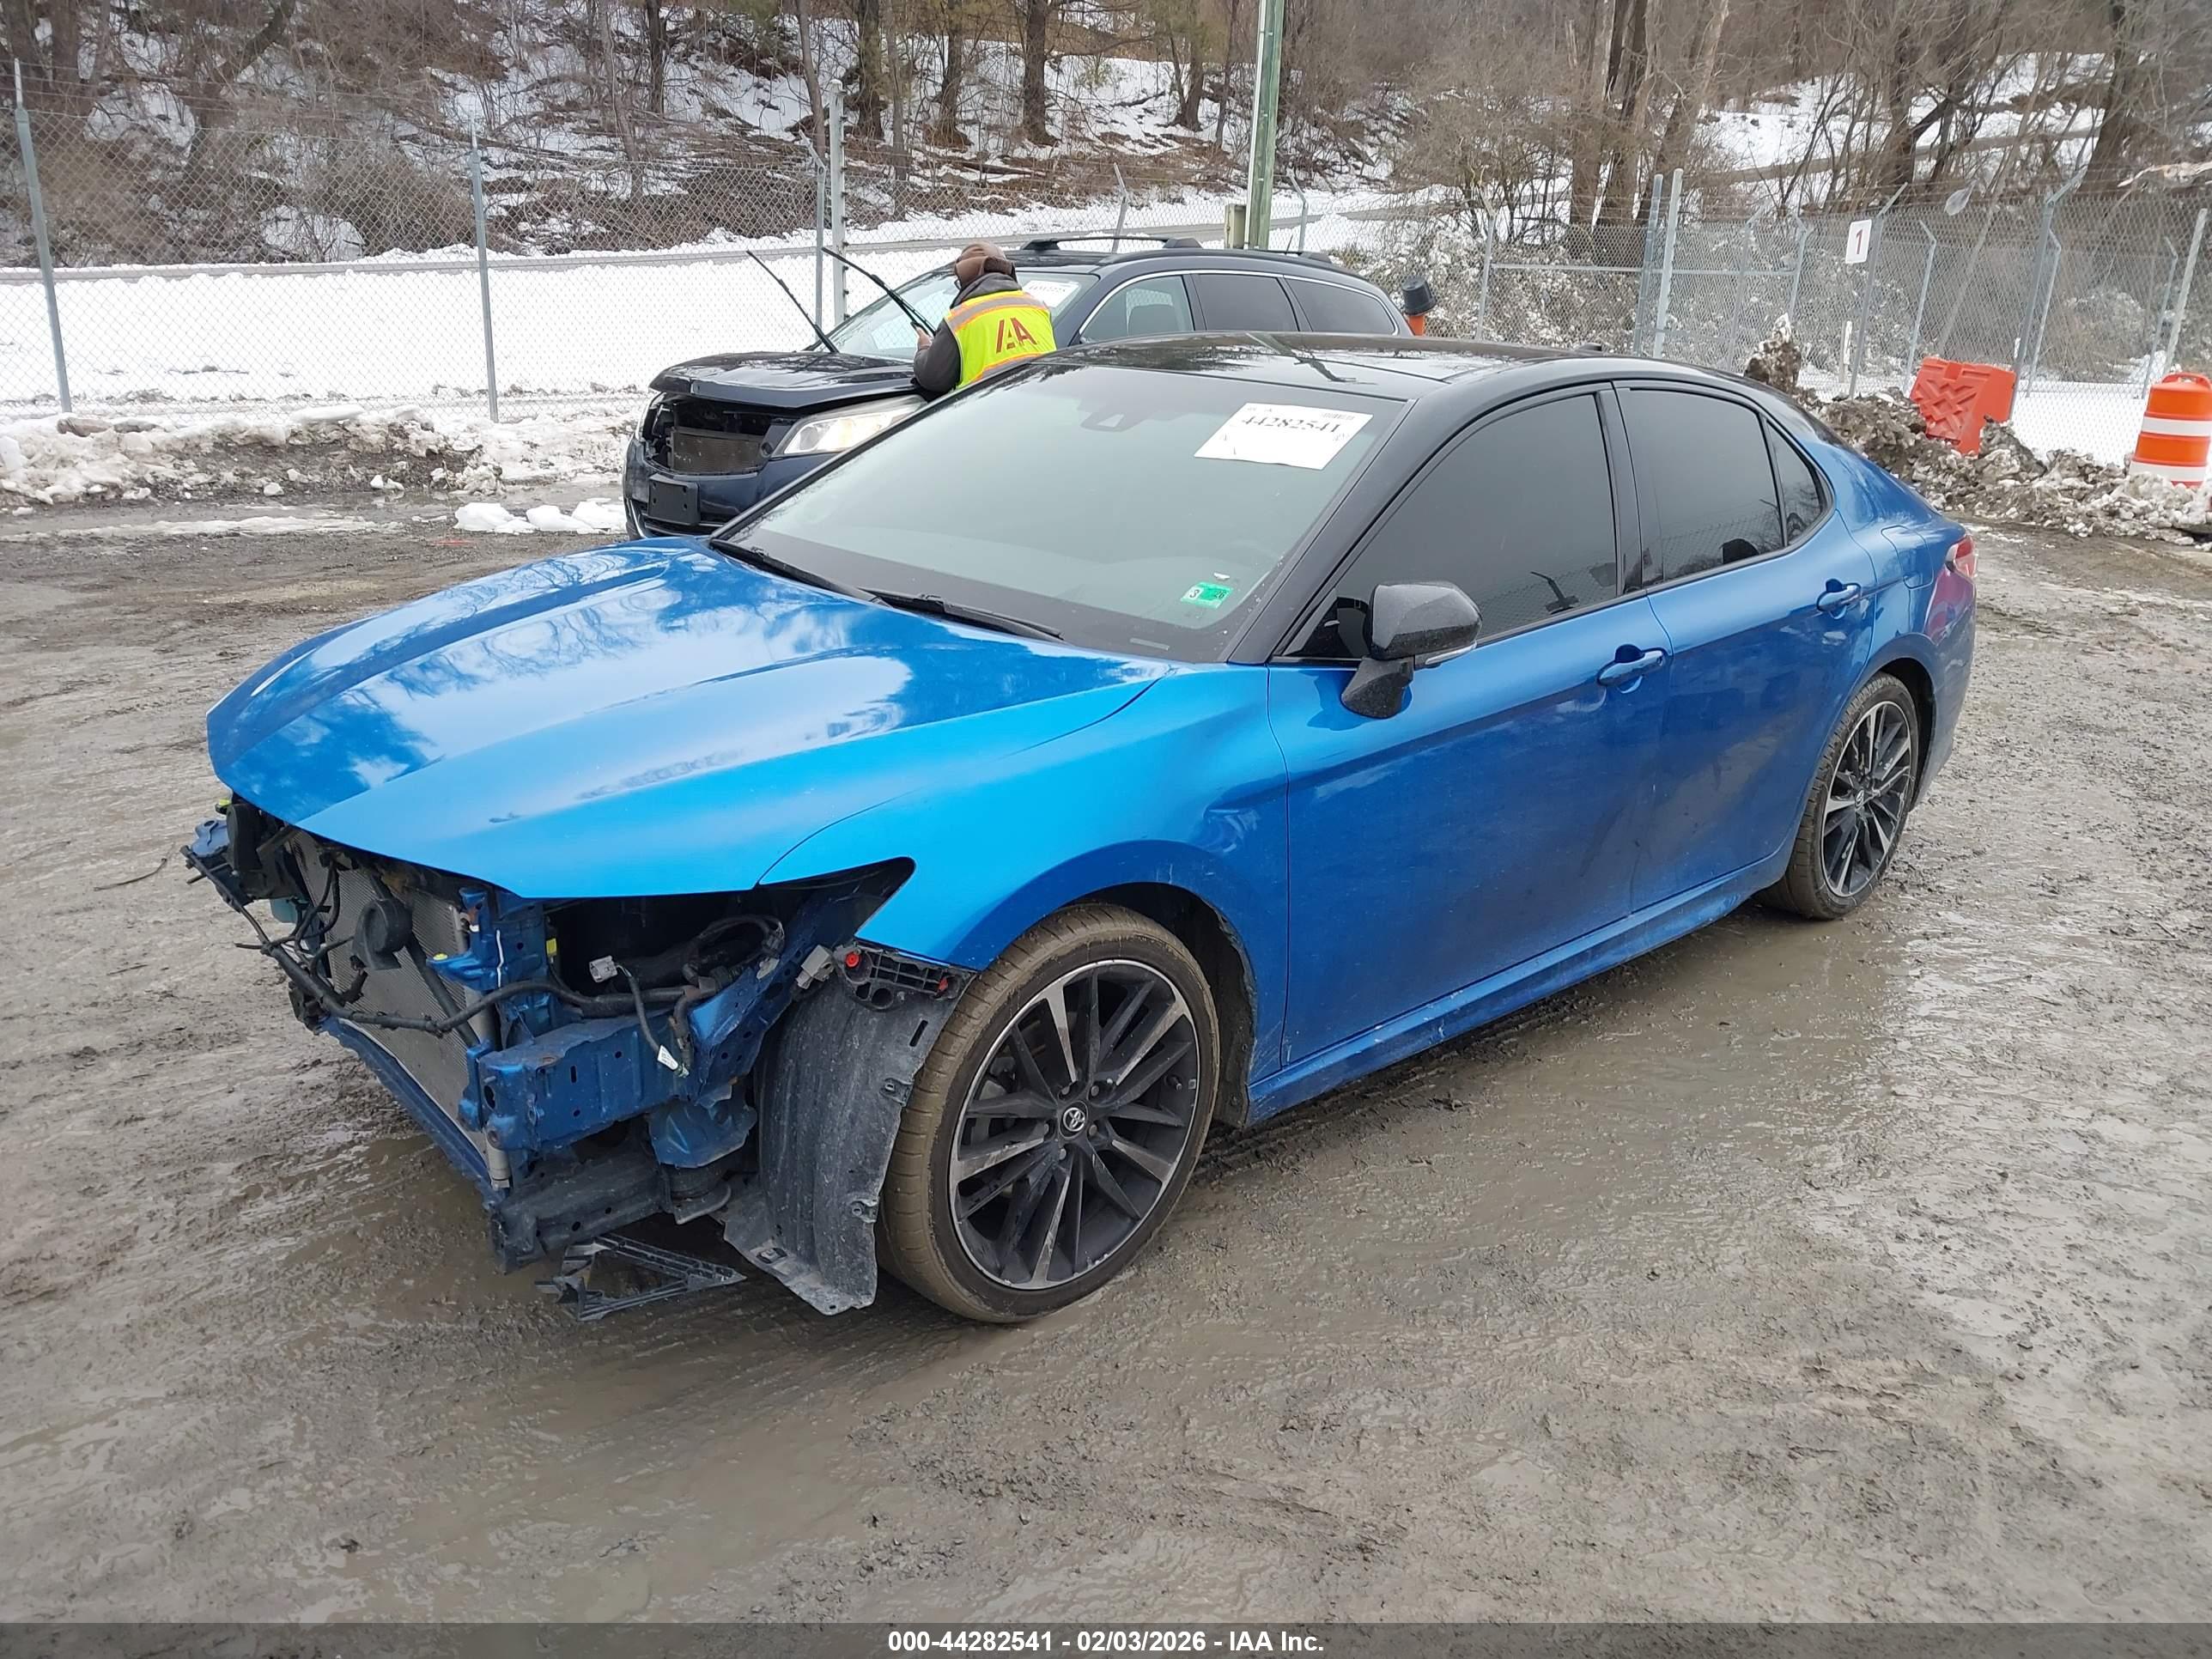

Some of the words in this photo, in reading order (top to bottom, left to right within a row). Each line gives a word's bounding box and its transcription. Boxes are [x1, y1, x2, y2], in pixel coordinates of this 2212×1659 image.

[1856, 228, 1863, 255] 1
[1241, 415, 1341, 433] 44282541
[1188, 589, 1200, 599] 3
